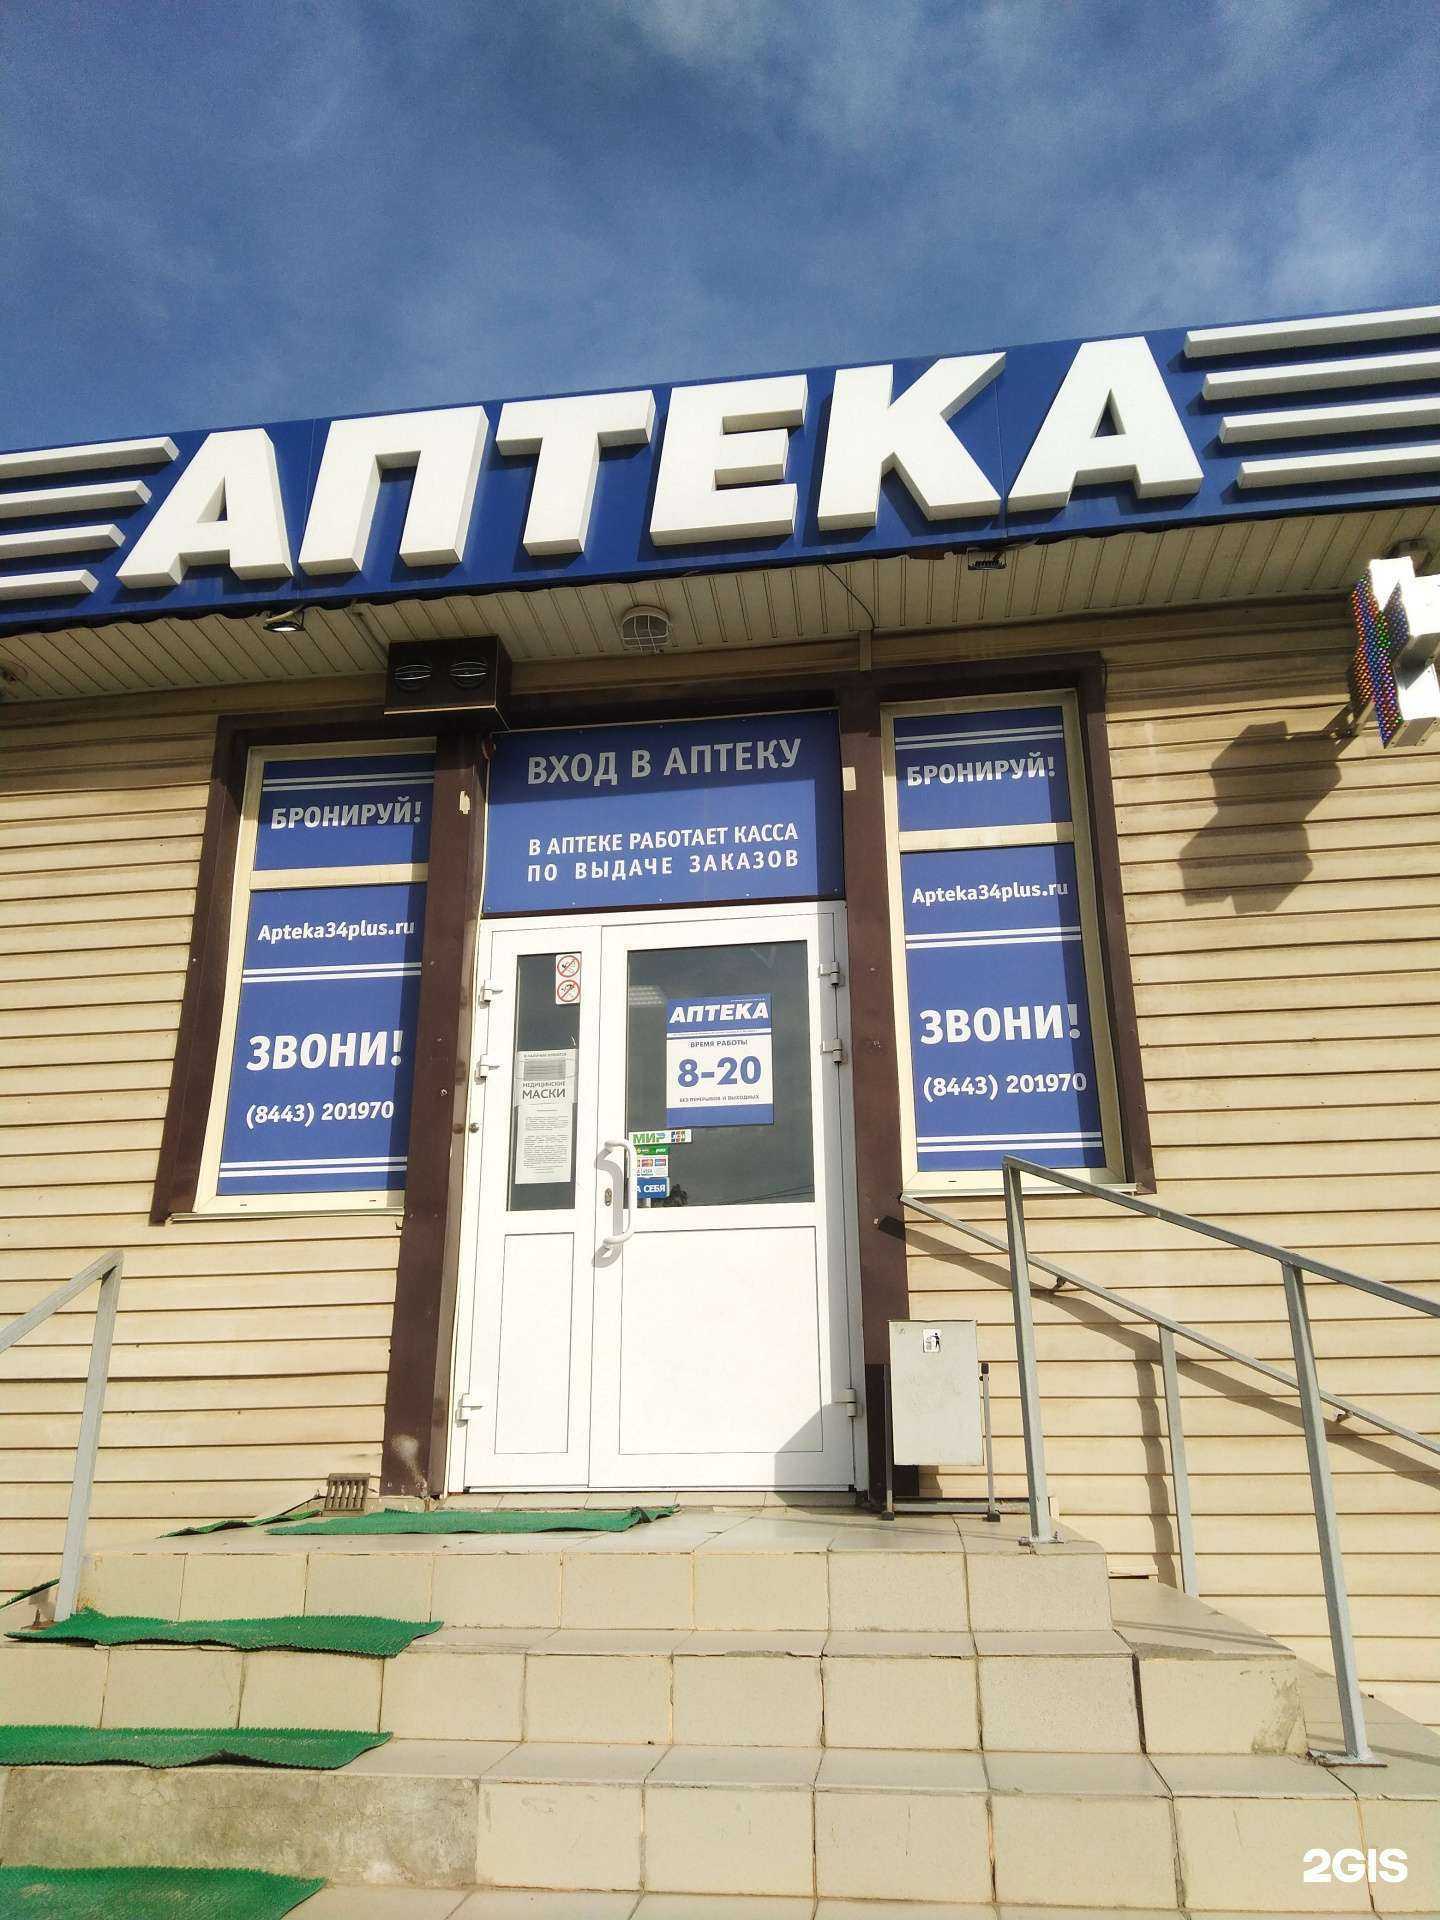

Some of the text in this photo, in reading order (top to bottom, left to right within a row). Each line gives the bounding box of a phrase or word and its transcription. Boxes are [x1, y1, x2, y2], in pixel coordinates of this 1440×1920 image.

[116, 336, 1203, 590] АПТЕКА
[527, 738, 801, 787] ВХОД В АПТЕКУ
[907, 752, 1056, 787] БРОНИРУЙ!
[270, 796, 423, 830] БРОНИРУЙ!
[528, 822, 799, 856] В АПТЕКЕ РАБОТАЕТ КАССА
[527, 849, 799, 882] ПО ВЫДАЧЕ ЗАКАЗОВ
[911, 881, 1068, 905] Apteka34plus.ru
[257, 919, 415, 942] Apteka34plus.ru
[669, 1002, 769, 1024] АПТЕКА
[919, 1003, 1081, 1045] ЗВОНИ!
[246, 1029, 404, 1072] ЗВОНИ!
[717, 1039, 748, 1047] РАБОТЫ
[522, 1088, 566, 1099] МАСКИ
[923, 1072, 1087, 1102] (8443) 201970
[245, 1100, 394, 1129] (8443) 201970
[632, 1132, 666, 1143] МИР
[643, 1184, 666, 1193] СЕБЯ
